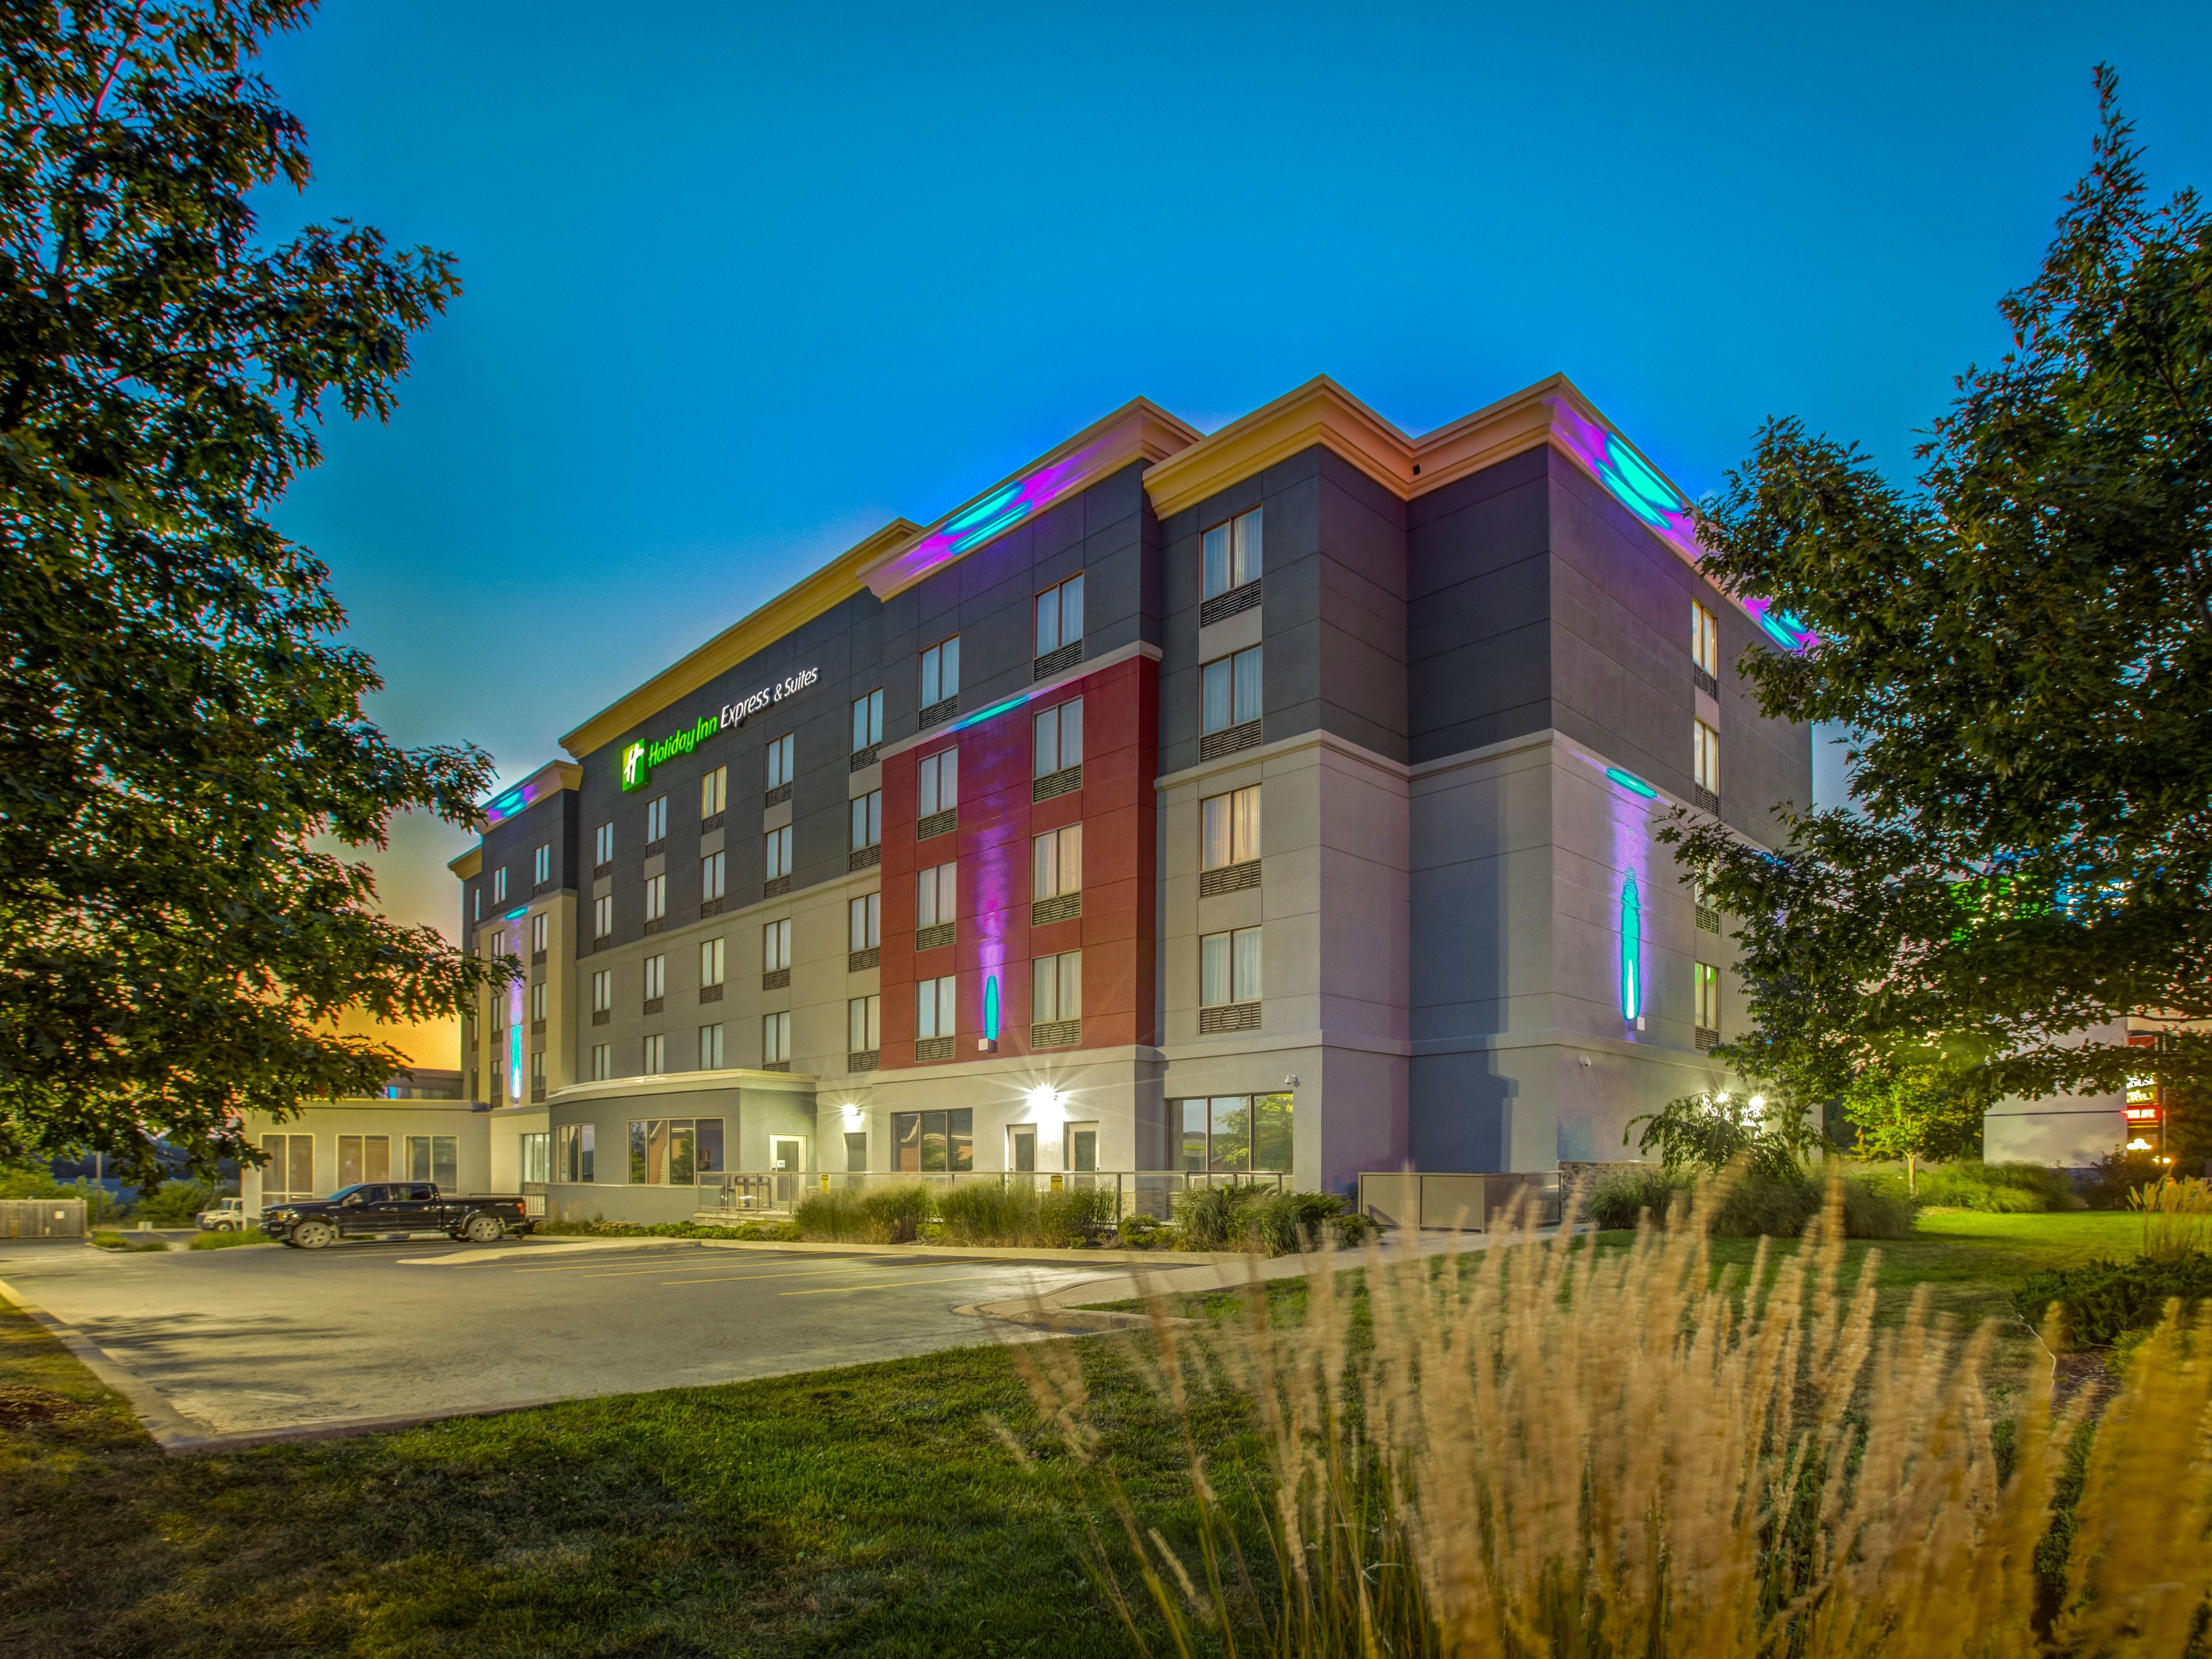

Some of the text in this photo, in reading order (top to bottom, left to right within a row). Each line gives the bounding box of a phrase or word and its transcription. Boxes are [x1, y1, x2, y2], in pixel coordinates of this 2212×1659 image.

[648, 667, 818, 768] Holiday Inn Express & Suites
